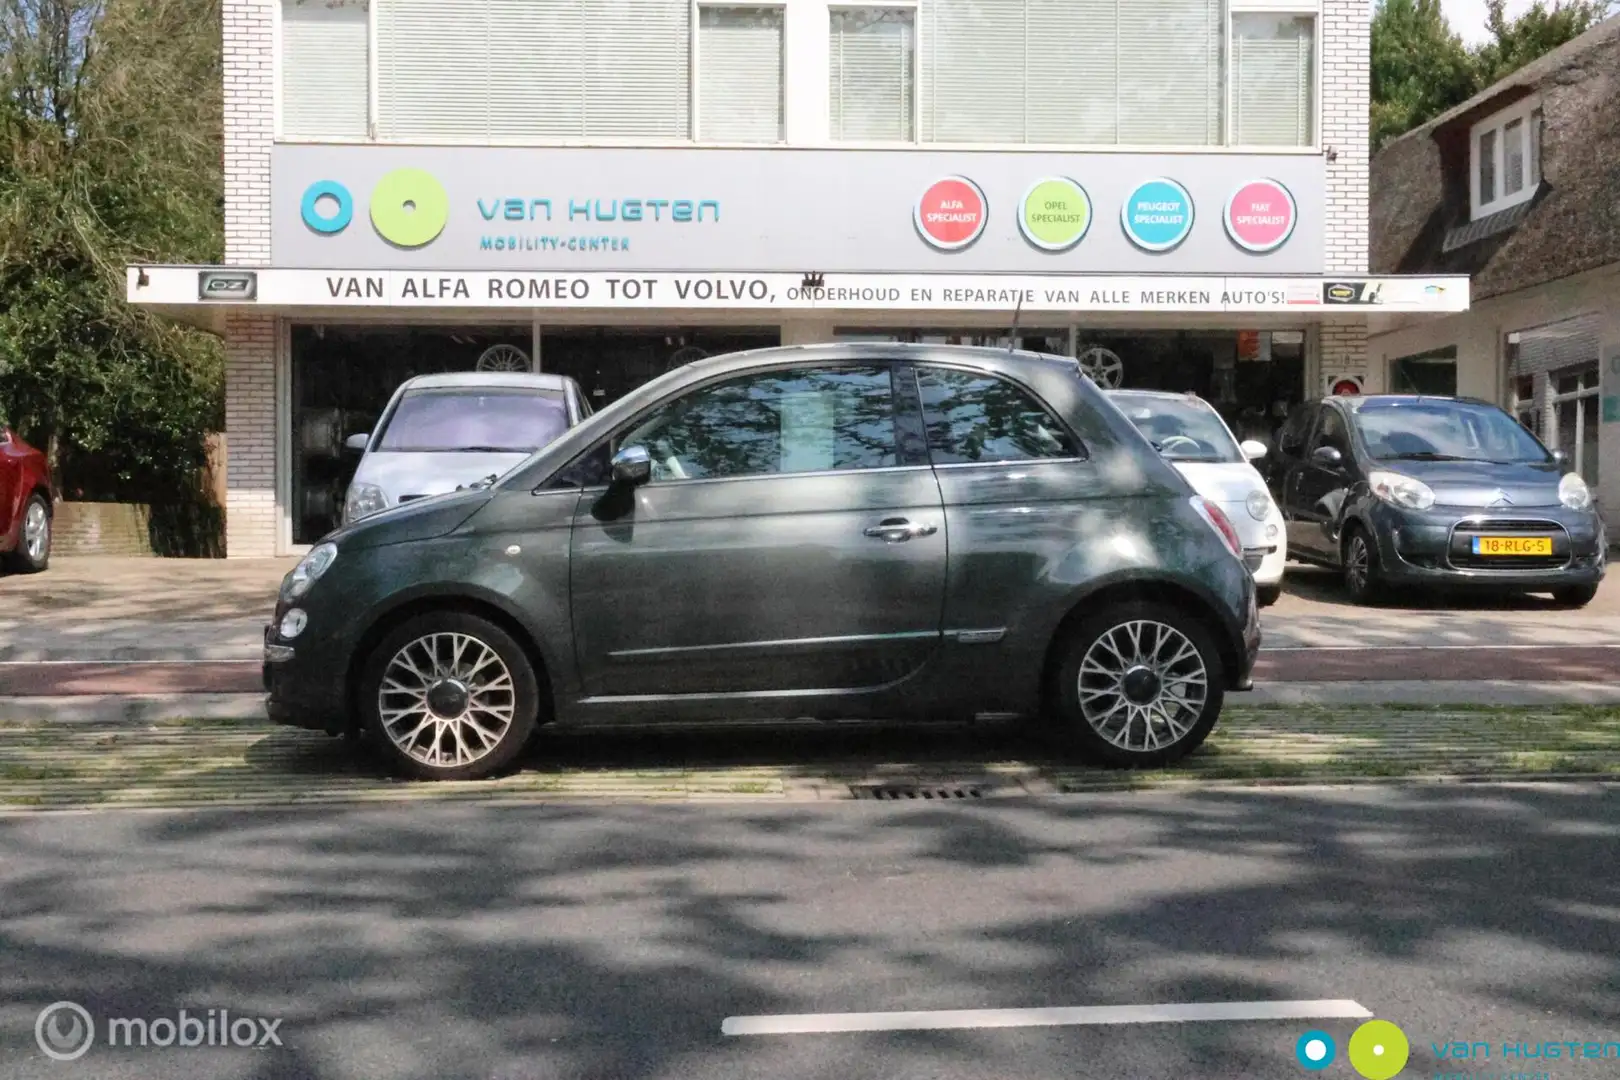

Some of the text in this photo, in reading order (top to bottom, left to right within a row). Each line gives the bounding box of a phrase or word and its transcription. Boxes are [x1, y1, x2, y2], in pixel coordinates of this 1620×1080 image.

[940, 200, 963, 209] ALFA
[1044, 201, 1067, 211] OPEL
[1137, 202, 1180, 211] PEUGEOT
[1251, 202, 1271, 212] FIAT
[927, 213, 977, 223] SPECIALIST
[1031, 213, 1080, 223] SPECIALIST
[1134, 214, 1184, 224] SPECIALIST
[1236, 215, 1285, 225] SPECIALIST
[326, 277, 384, 298] VAN
[401, 277, 470, 299] ALFA
[488, 278, 589, 300] ROMEO
[606, 279, 658, 300] TOT
[675, 279, 776, 303] VOLVO,
[787, 287, 900, 301] ONDERHOUD
[911, 288, 932, 301] EN
[1044, 290, 1079, 303] VAN
[1090, 290, 1130, 303] ALLE
[1140, 291, 1210, 304] MERKEN
[1220, 291, 1286, 304] AUTO'S!
